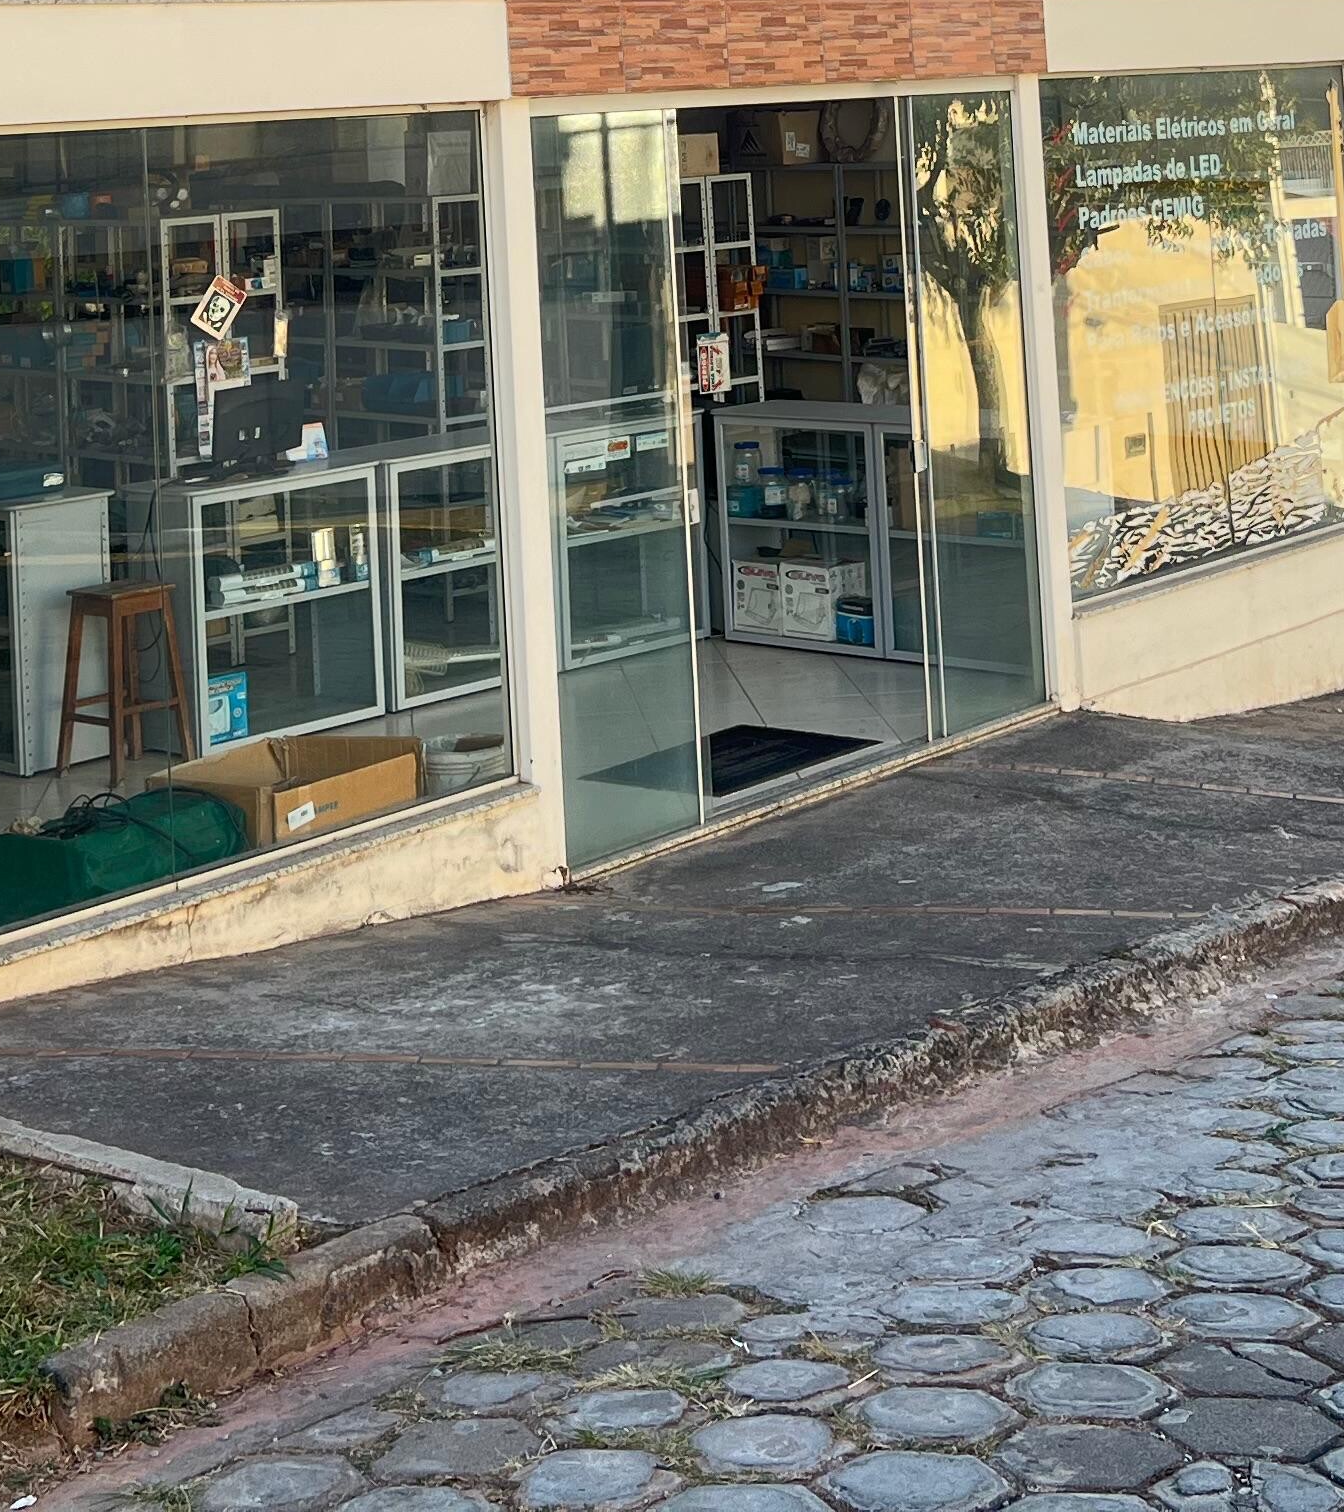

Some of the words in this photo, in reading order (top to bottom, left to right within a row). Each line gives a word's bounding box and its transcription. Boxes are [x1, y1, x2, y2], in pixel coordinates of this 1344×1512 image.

[1073, 120, 1153, 146] Materiais
[1156, 114, 1226, 140] Elétricos
[1230, 116, 1253, 134] em
[1075, 160, 1162, 190] Lampadas
[1165, 157, 1186, 180] de
[1189, 154, 1221, 179] LED
[1150, 195, 1205, 223] CEMIG
